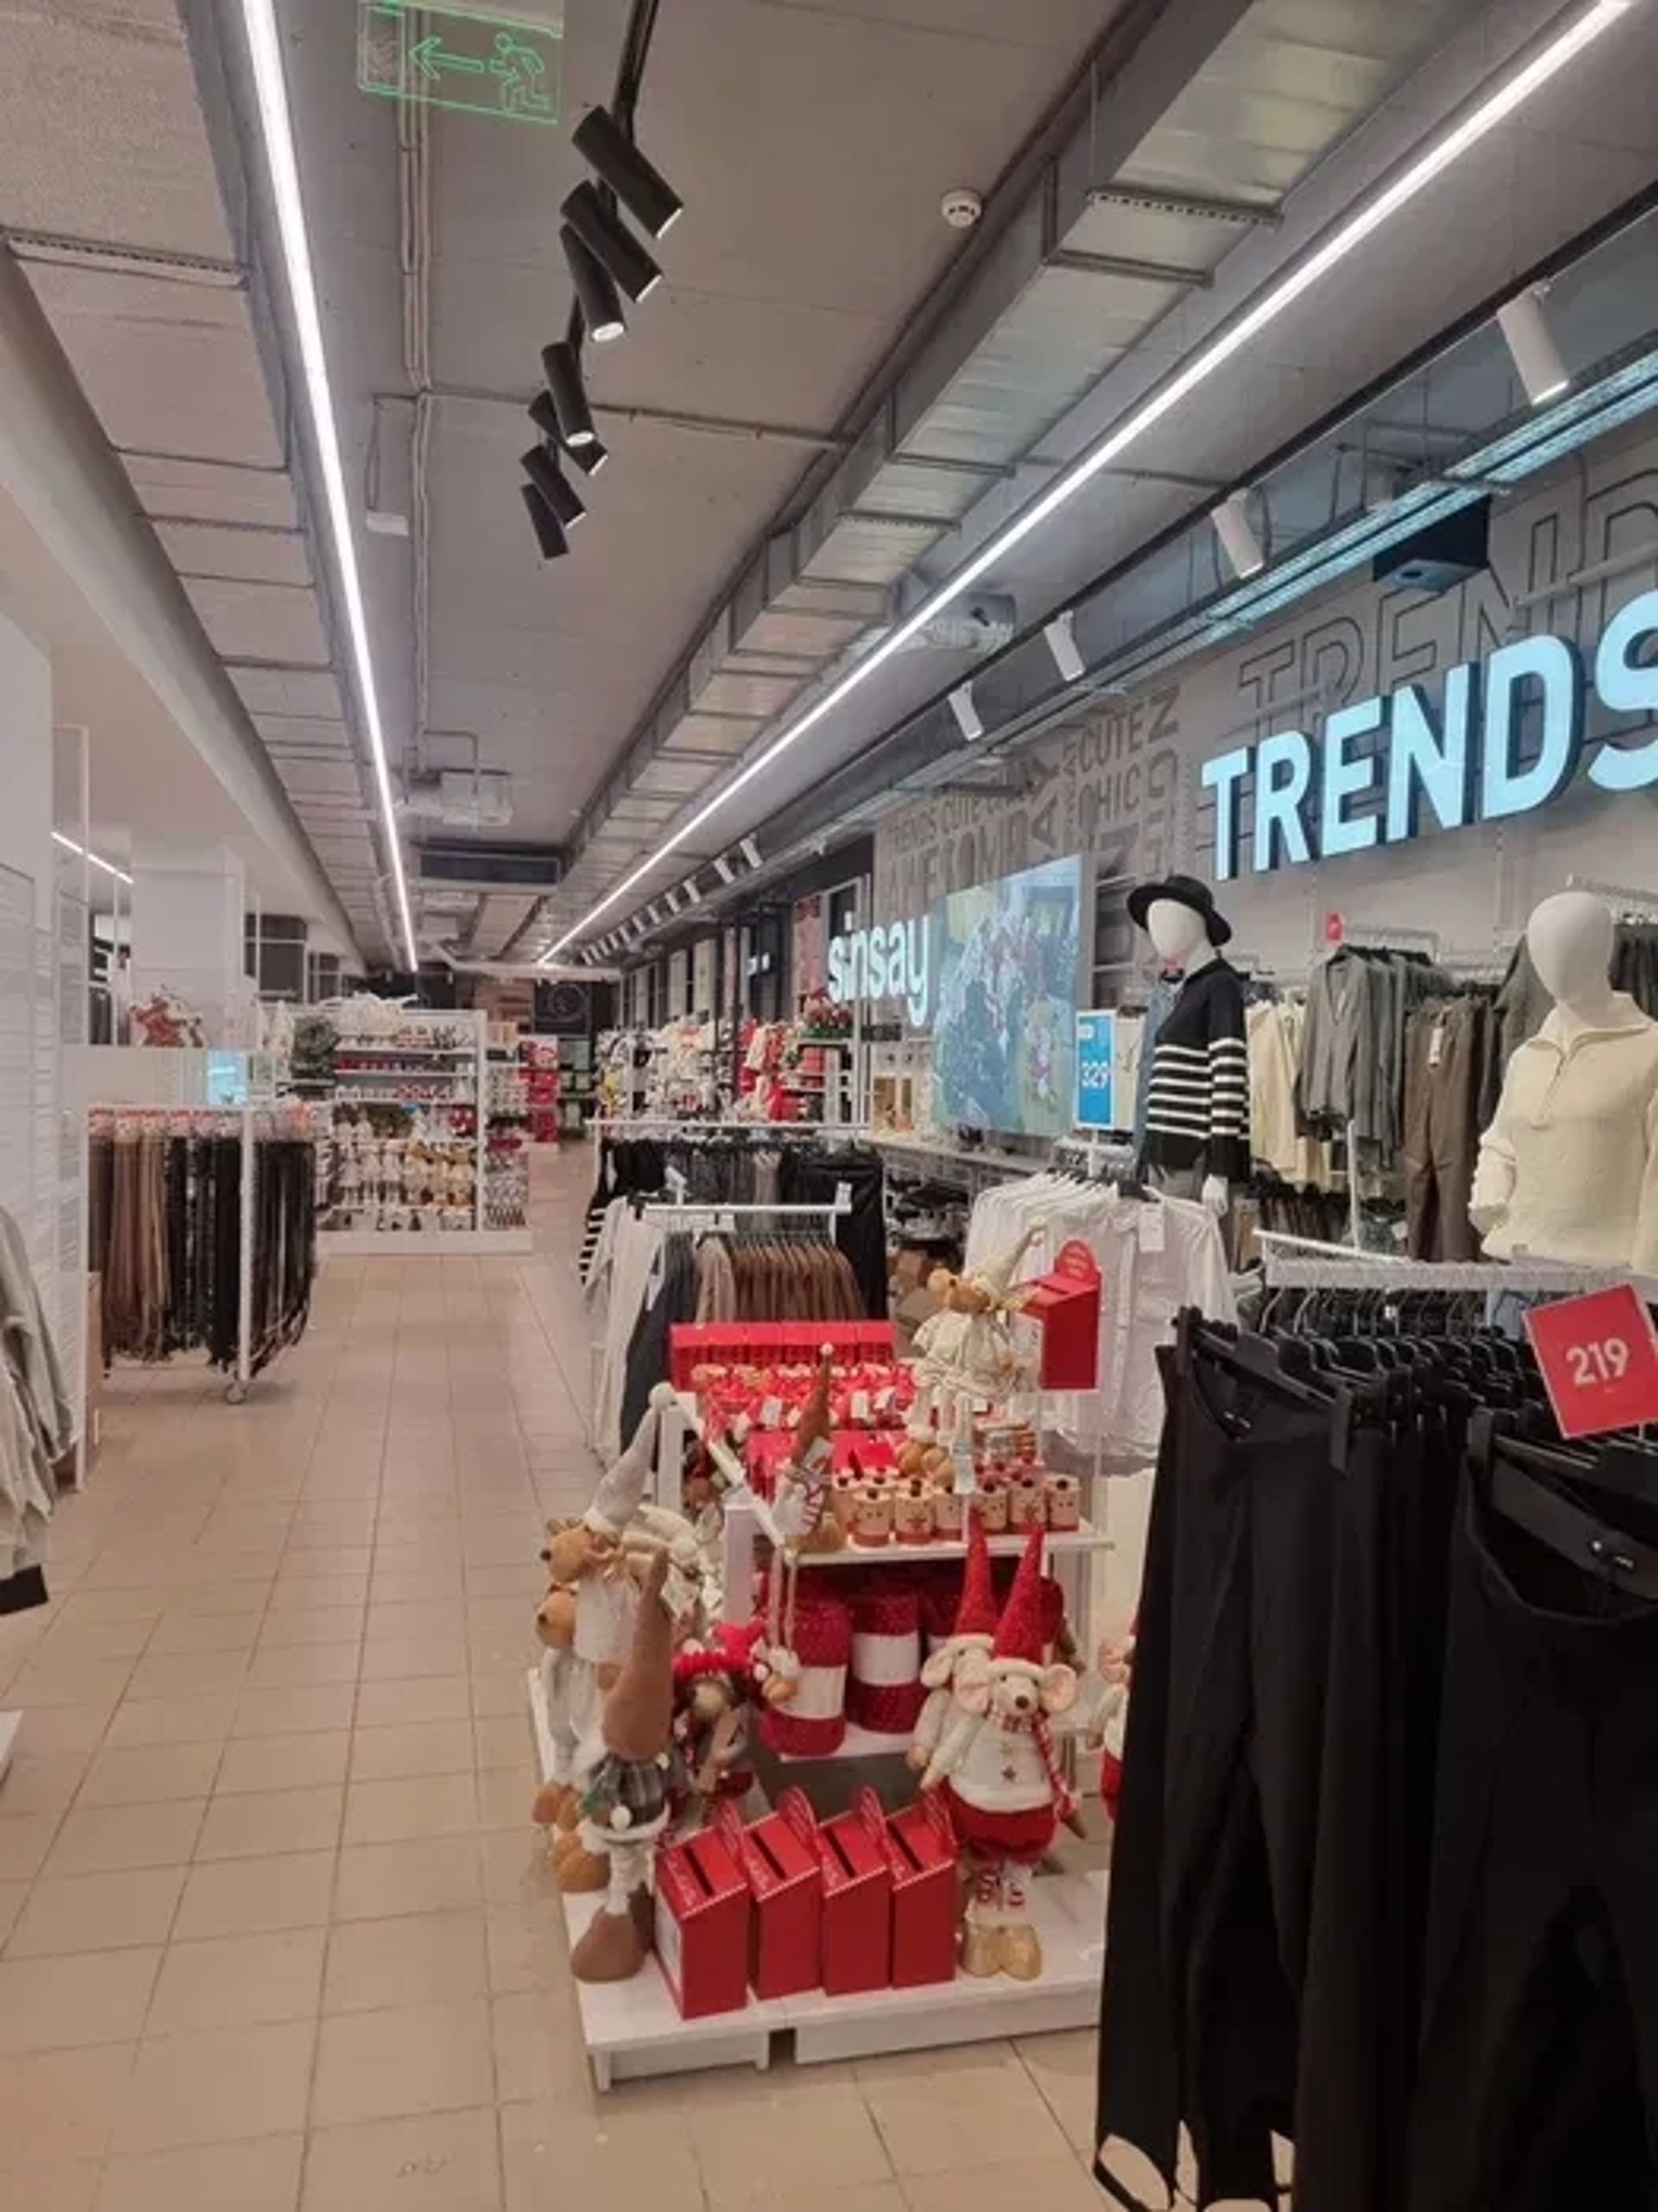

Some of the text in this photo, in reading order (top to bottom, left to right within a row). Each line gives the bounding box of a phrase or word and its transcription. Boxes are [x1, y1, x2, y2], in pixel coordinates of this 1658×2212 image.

[1080, 701, 1144, 773] CUTE
[828, 910, 929, 1028] sinsay
[1566, 1337, 1629, 1386] 219
